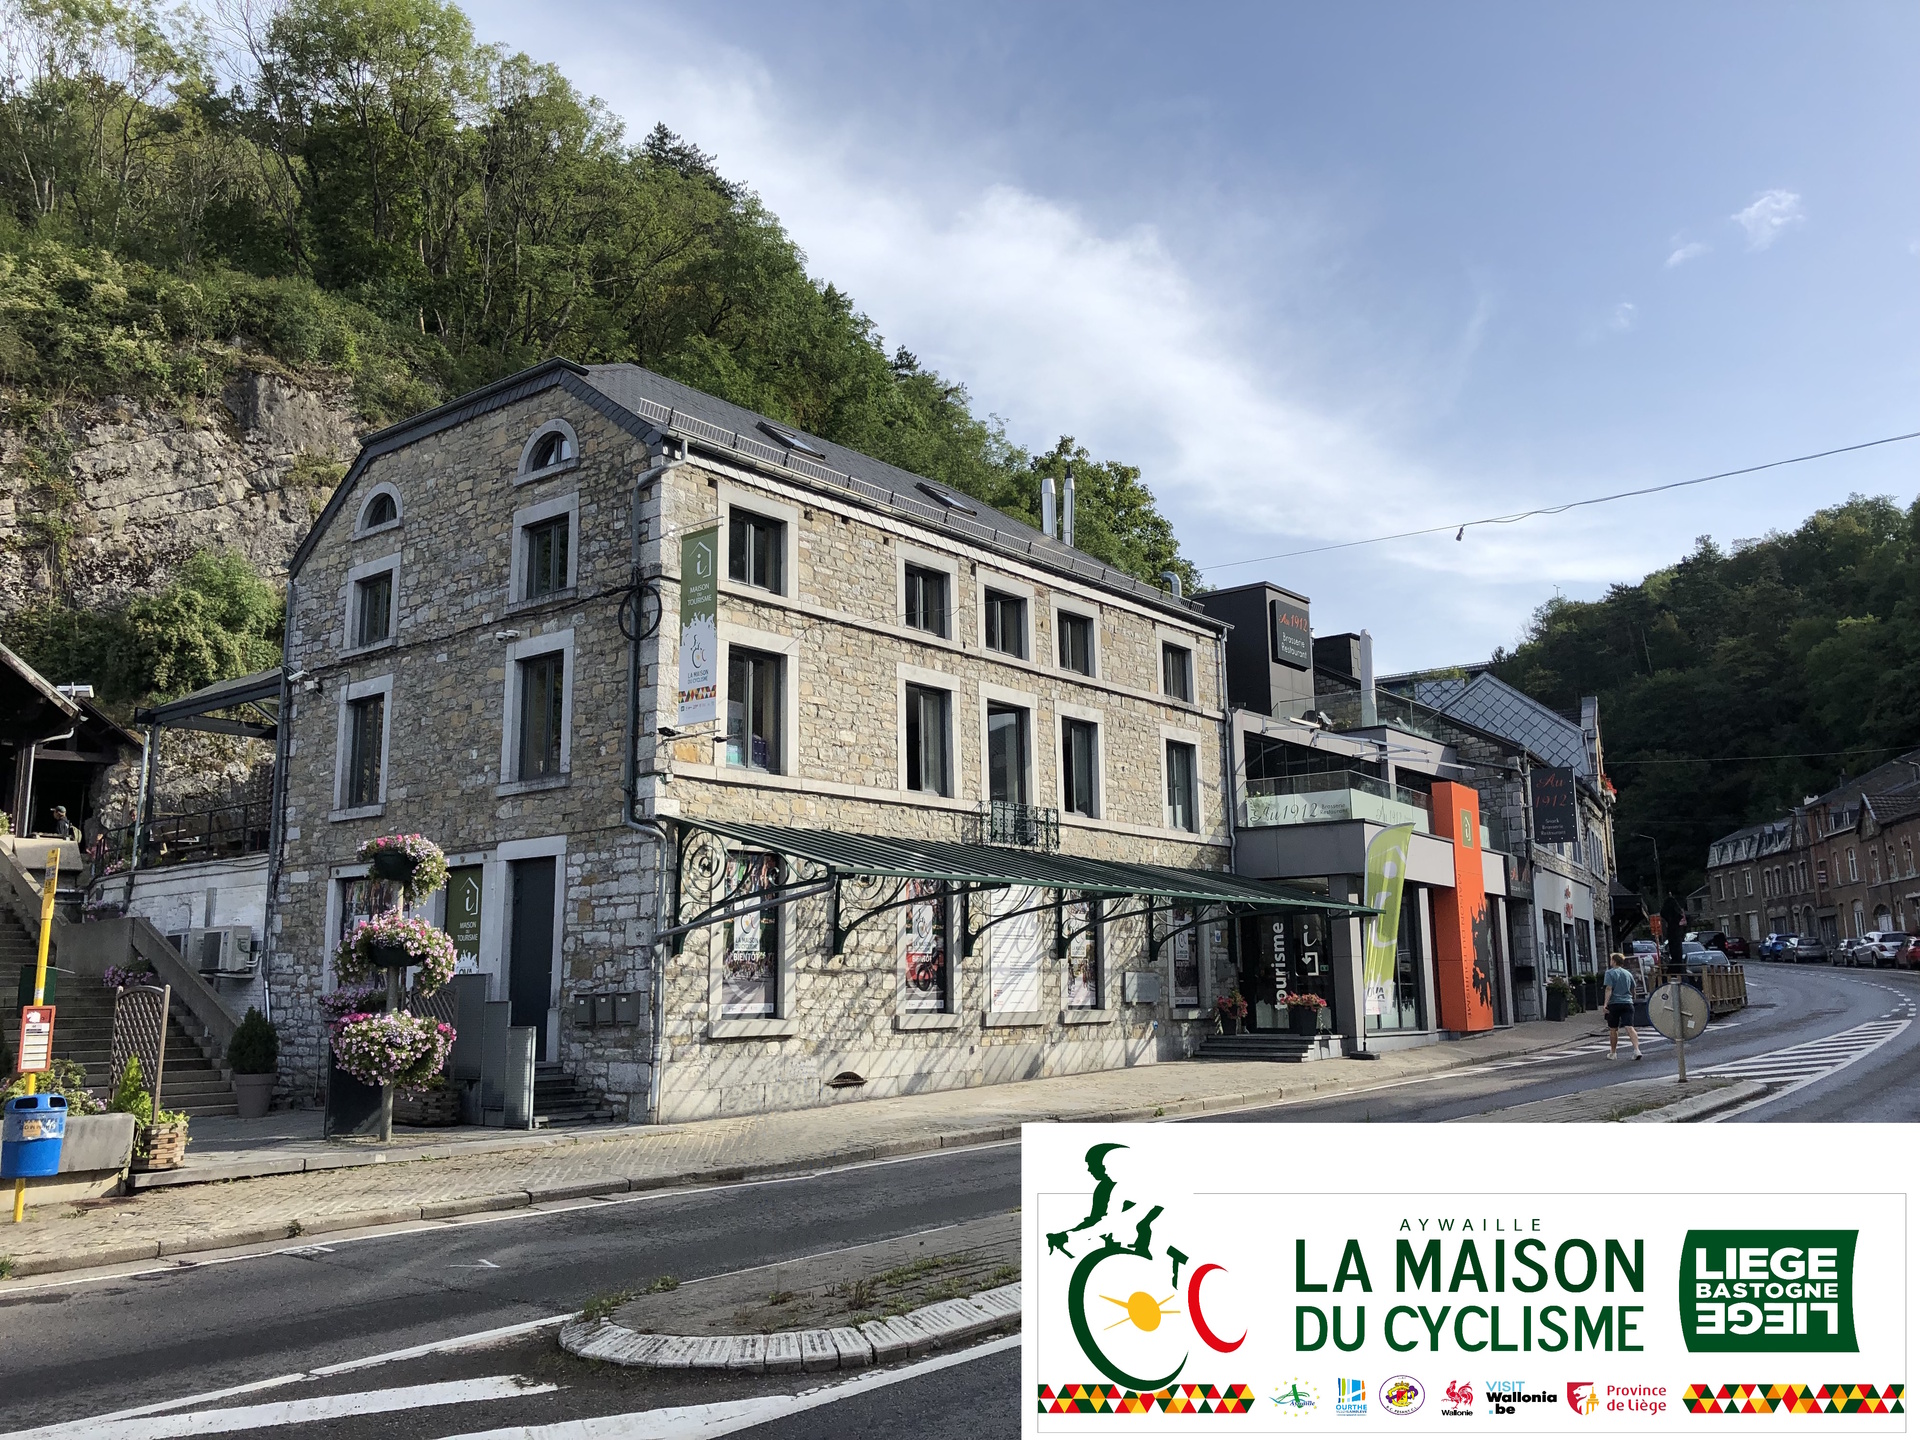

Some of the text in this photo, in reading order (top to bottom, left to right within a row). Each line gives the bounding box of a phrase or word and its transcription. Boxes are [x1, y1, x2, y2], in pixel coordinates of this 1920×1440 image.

[689, 583, 710, 593] MAISON
[687, 594, 712, 606] TOURISME
[1291, 614, 1308, 632] 1912
[1282, 631, 1305, 648] Brasserie
[1281, 642, 1308, 659] Restaurant
[1536, 773, 1563, 788] Au
[1536, 794, 1567, 808] 1912
[1250, 802, 1319, 822] Au 1912
[459, 921, 477, 929] MAISON
[457, 933, 479, 942] TOURISME
[1457, 873, 1472, 1020] MAISON DU TOURISME
[1271, 922, 1288, 1010] tourisme
